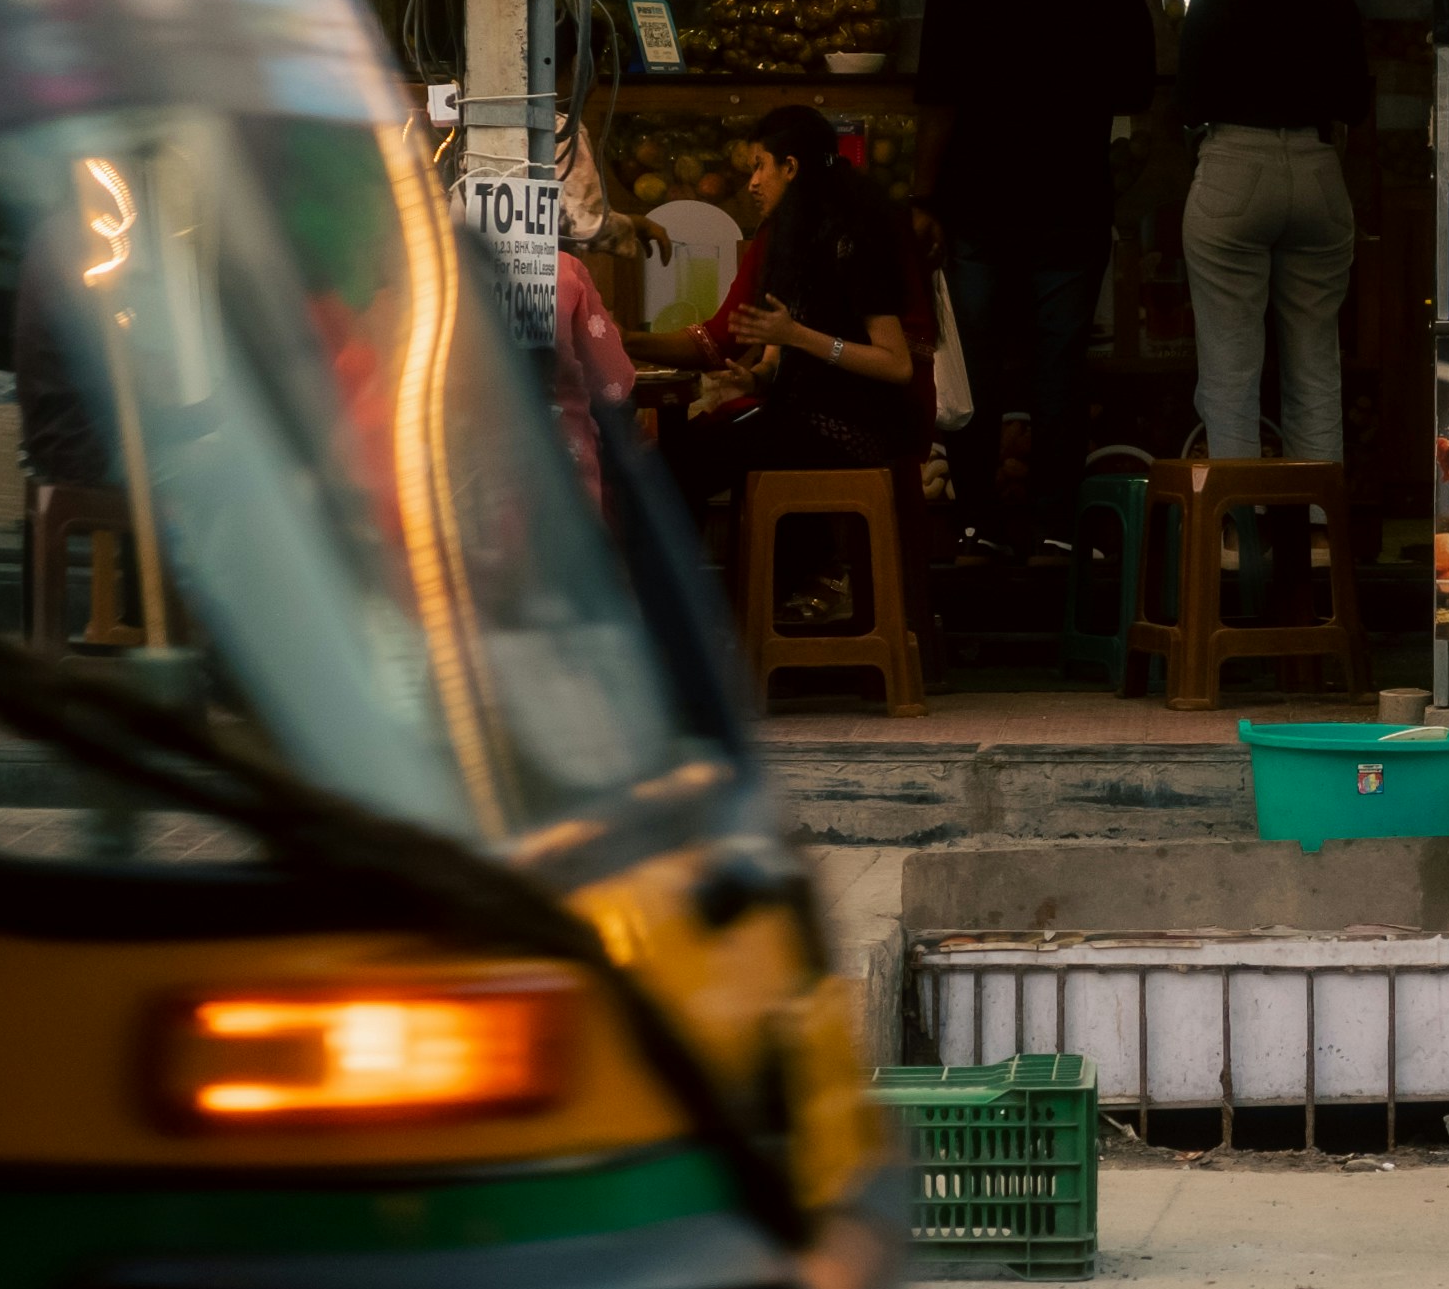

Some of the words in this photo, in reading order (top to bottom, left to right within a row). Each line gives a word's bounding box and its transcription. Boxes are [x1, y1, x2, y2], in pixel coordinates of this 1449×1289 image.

[475, 183, 558, 235] TO-LET
[515, 241, 530, 254] BHK
[513, 259, 532, 274] Rent
